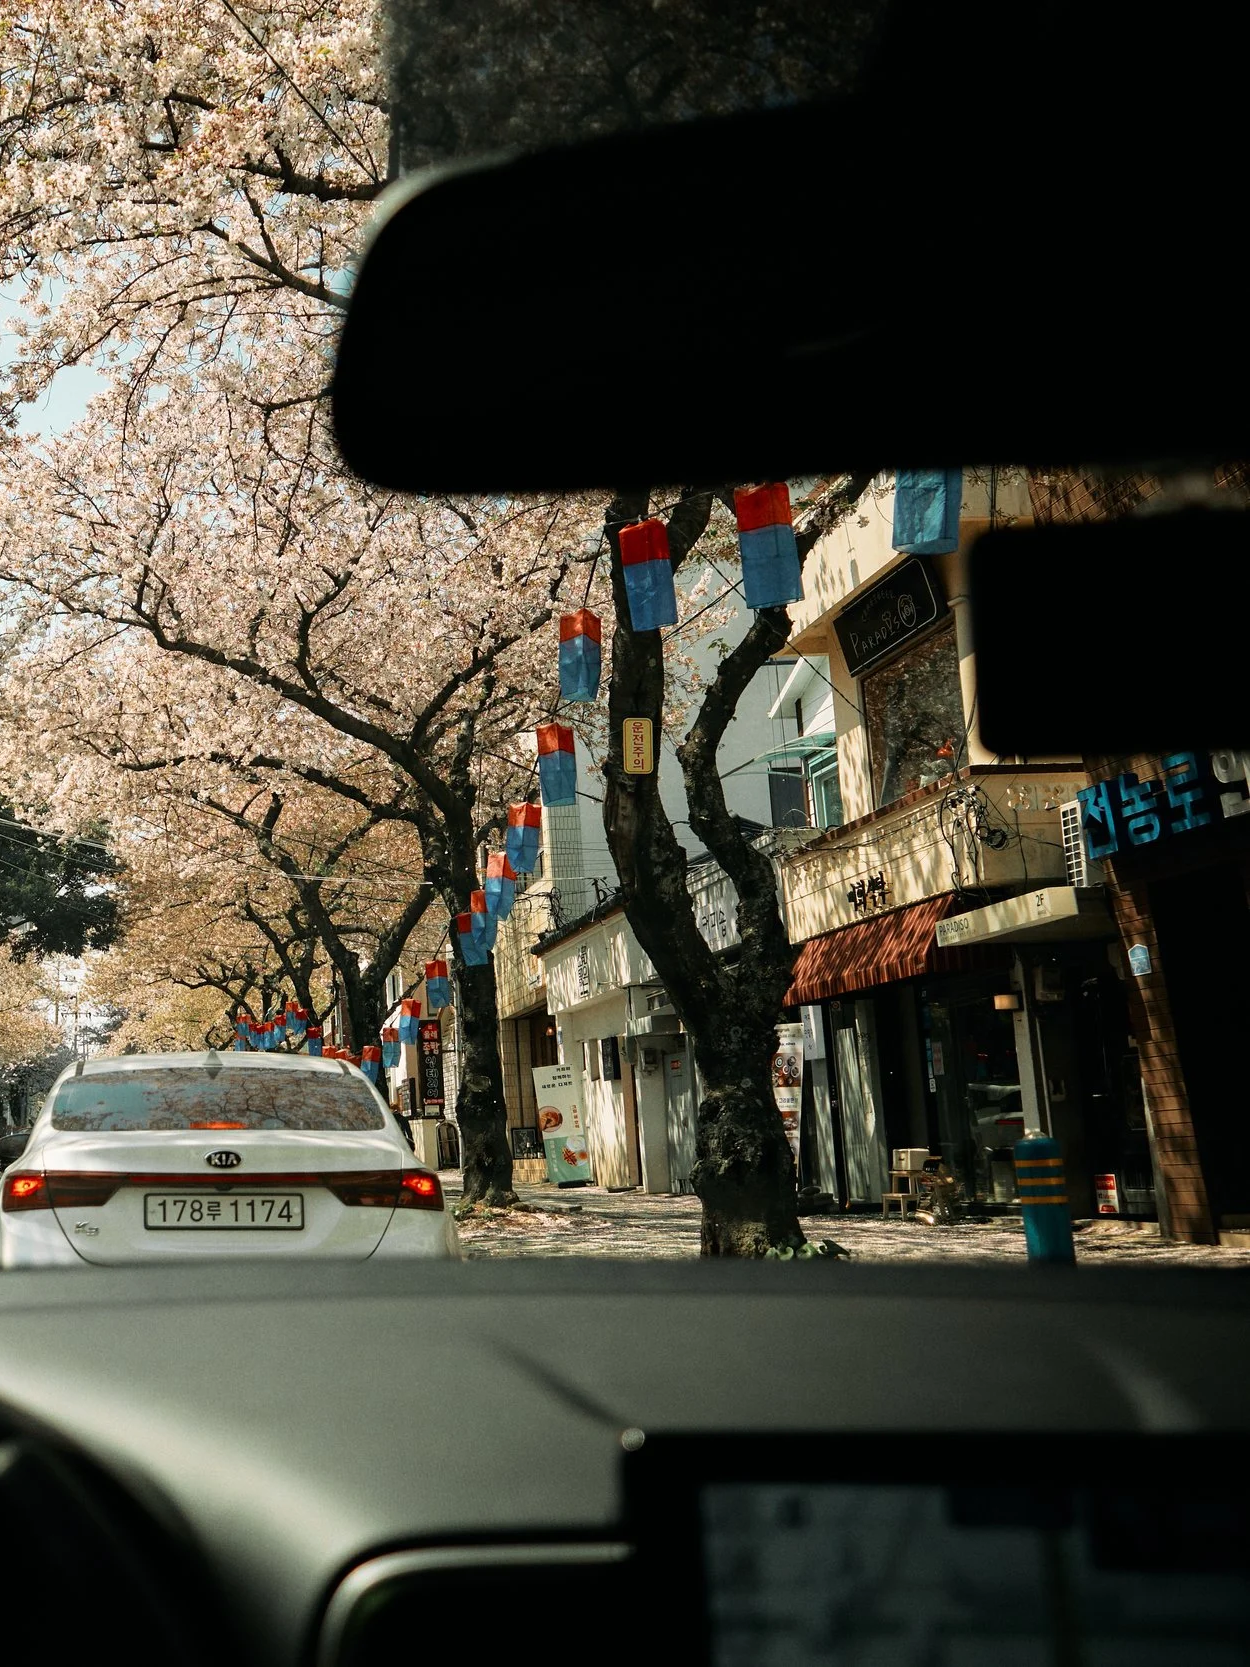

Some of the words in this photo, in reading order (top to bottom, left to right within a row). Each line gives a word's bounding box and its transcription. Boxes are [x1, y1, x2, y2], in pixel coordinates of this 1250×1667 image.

[632, 721, 644, 770] 운전주의
[1035, 893, 1044, 907] 2F
[939, 918, 969, 936] PARADISO
[210, 1153, 238, 1166] KIA
[157, 1200, 222, 1223] 178루
[230, 1200, 293, 1223] 1174
